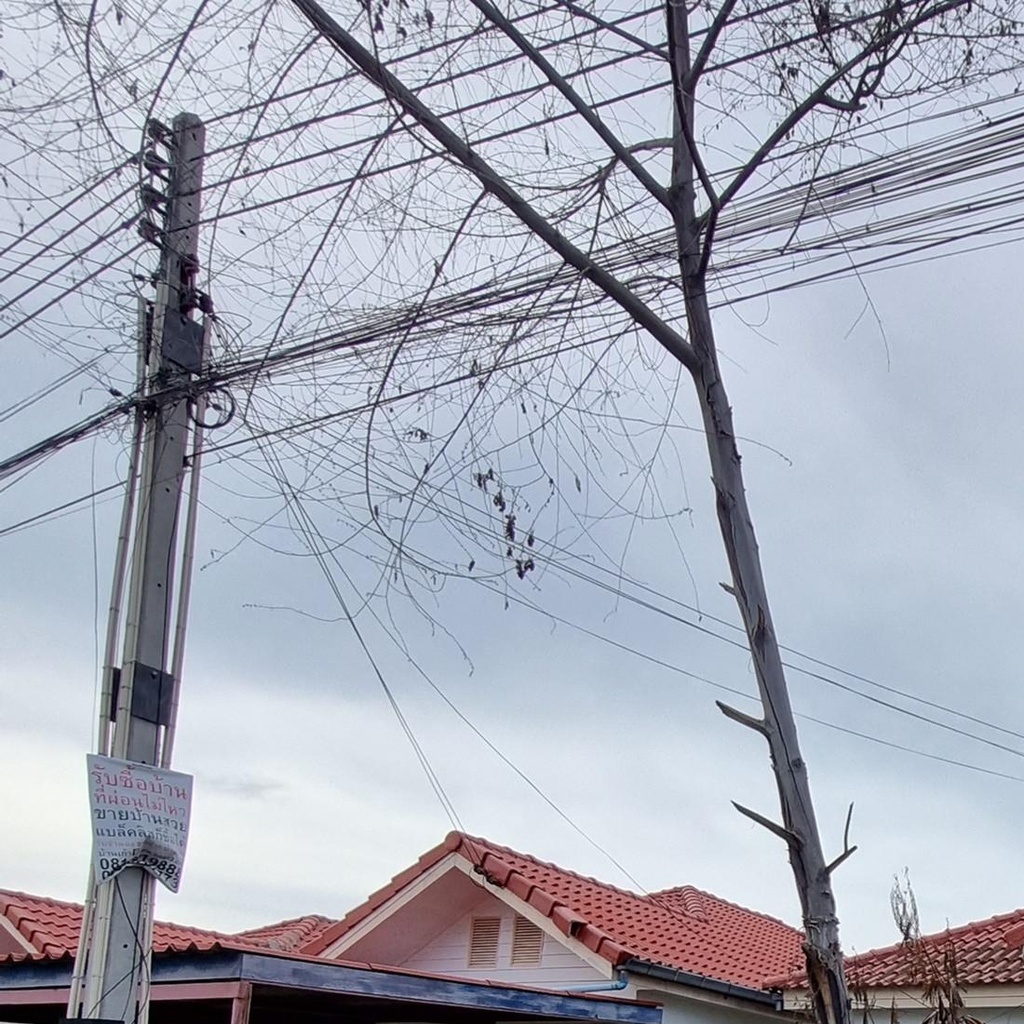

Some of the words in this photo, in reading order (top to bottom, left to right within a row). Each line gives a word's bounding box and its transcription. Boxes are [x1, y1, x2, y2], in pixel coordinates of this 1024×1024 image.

[91, 763, 187, 800] รับซื้อบ้าน
[93, 784, 186, 817] ที่ผ่อนไม่ไหว
[93, 805, 187, 832] ขายบ้านสวย
